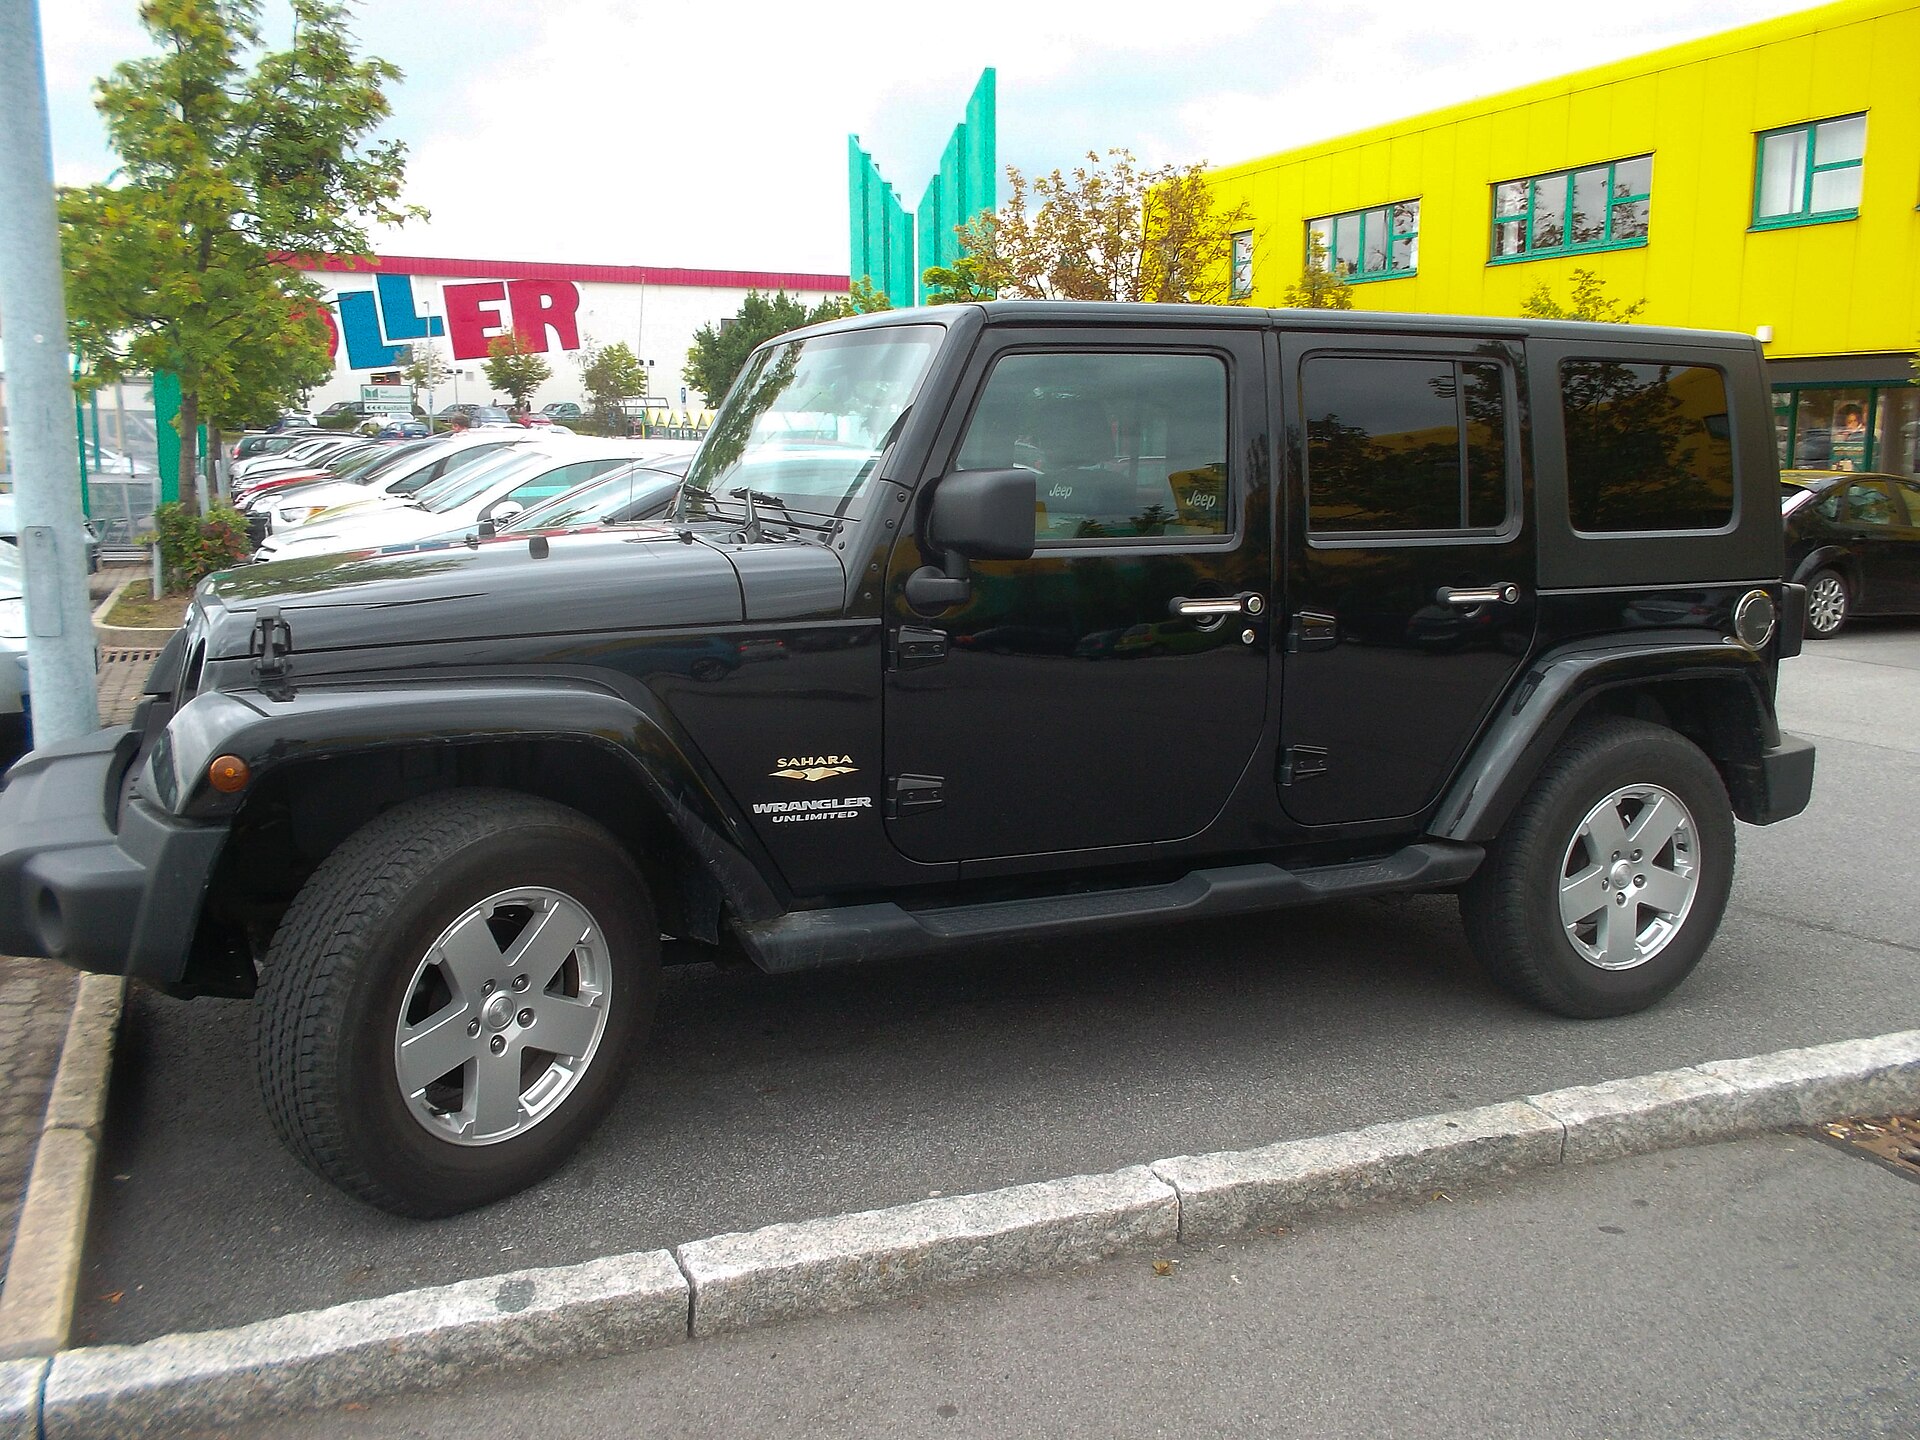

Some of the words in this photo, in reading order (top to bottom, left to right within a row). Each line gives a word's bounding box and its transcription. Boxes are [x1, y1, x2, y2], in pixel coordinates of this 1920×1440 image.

[312, 273, 580, 370] LLER
[1049, 483, 1073, 499] Jeep
[1186, 490, 1216, 510] Jeep
[777, 755, 853, 768] SAHARA
[753, 797, 872, 814] WRANGLER
[772, 811, 859, 823] UNLIMITED
